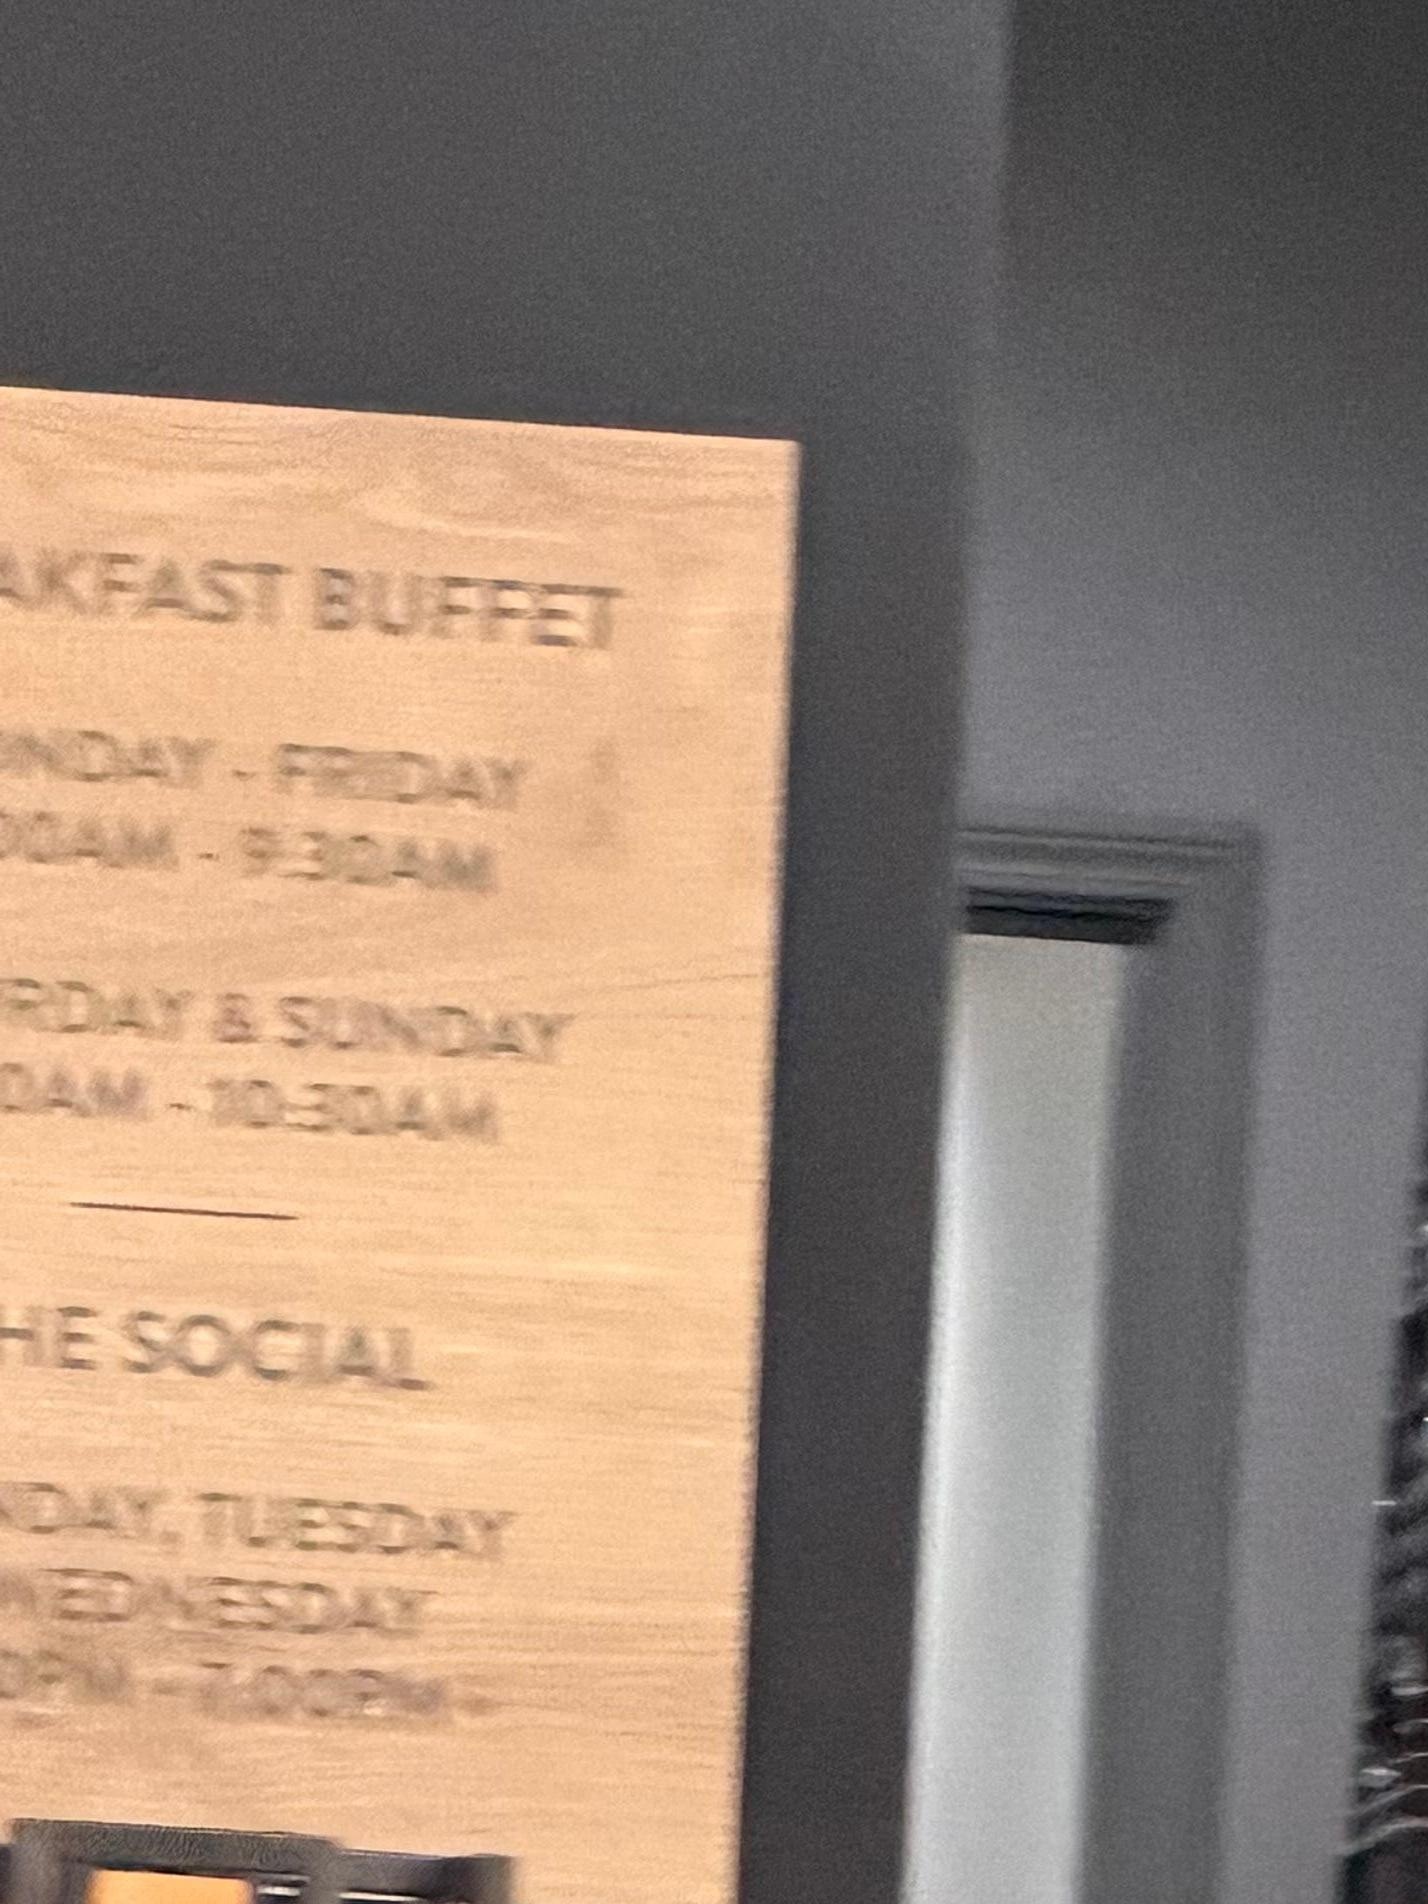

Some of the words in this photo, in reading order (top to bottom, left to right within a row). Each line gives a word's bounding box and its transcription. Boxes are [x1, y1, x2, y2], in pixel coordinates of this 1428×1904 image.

[314, 565, 625, 649] BUFFET
[275, 741, 528, 810] FRIDAY
[210, 991, 260, 1045] &
[279, 995, 579, 1064] SUNDAY
[122, 1309, 438, 1392] SOCIAL
[198, 1490, 519, 1561] TUESDAY
